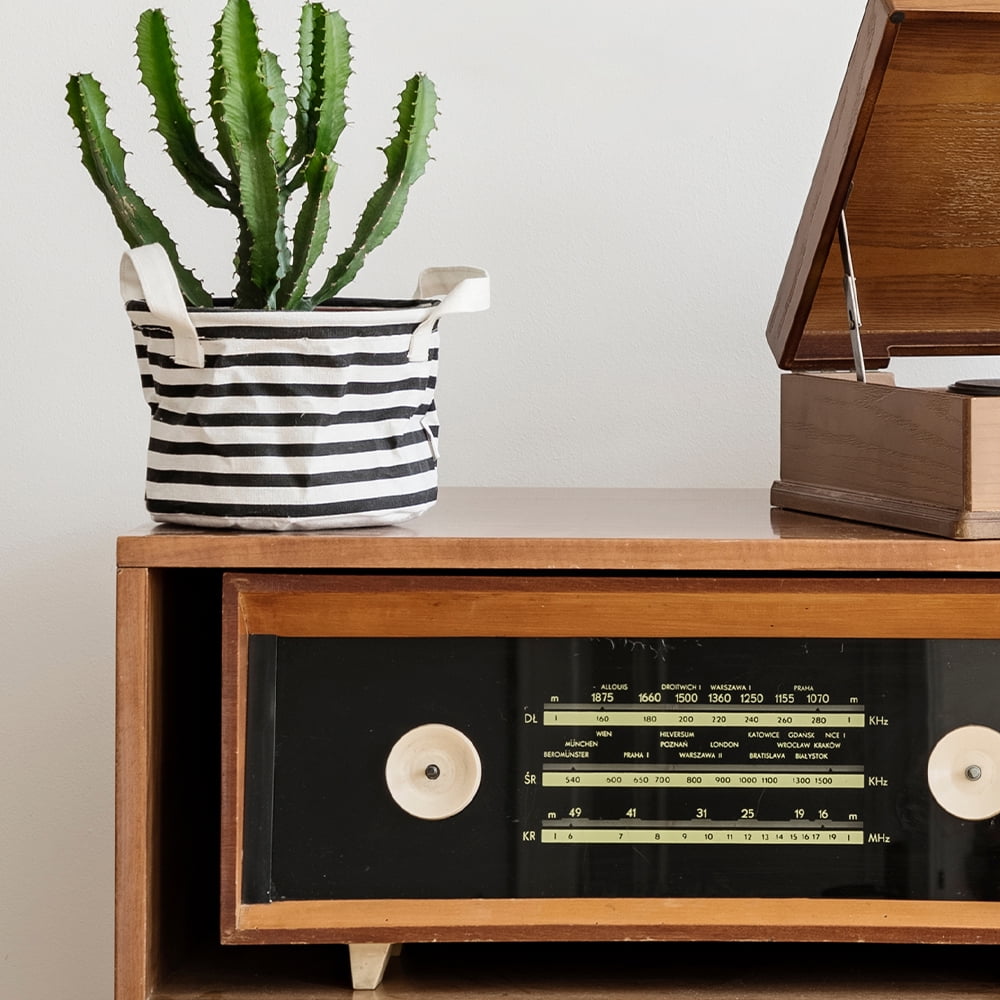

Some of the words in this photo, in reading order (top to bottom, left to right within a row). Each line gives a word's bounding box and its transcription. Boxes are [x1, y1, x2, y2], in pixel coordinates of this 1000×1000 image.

[600, 683, 629, 691] ALLOUIS
[660, 683, 697, 691] DROITWICH
[793, 684, 814, 692] PRAHA
[550, 695, 560, 703] m
[590, 692, 615, 703] 1875
[638, 692, 662, 703] 1660
[675, 692, 699, 704] 1500
[707, 692, 732, 704] 1360
[740, 692, 764, 704] 1250
[774, 693, 795, 704] 1155
[806, 693, 830, 704] 1070
[849, 696, 859, 704] m
[643, 715, 658, 723] 180
[678, 715, 694, 723] 200
[711, 715, 727, 724] 220
[744, 716, 759, 724] 240
[777, 716, 793, 724] 260
[811, 716, 827, 725] 280
[868, 715, 889, 726] KHz
[595, 730, 613, 738] WIEN
[659, 730, 695, 738] HILVERSUM
[747, 731, 780, 739] KATOWICE
[824, 731, 840, 739] NICE
[709, 740, 740, 749] LONDON
[623, 751, 644, 759] PRAHA
[678, 751, 716, 759] WARSZAWA
[749, 752, 786, 760] BRATISLAVA
[524, 771, 537, 785] ŚR
[565, 776, 581, 784] 540
[606, 776, 623, 784] 600
[633, 776, 649, 784] 650
[655, 776, 671, 784] 700
[686, 776, 703, 784] 800
[714, 776, 731, 784] 900
[738, 776, 758, 784] 1000
[761, 776, 778, 784] 1100
[814, 776, 833, 785] 1500
[868, 776, 889, 787] KHz
[547, 811, 557, 819] m
[568, 807, 582, 818] 49
[625, 807, 637, 818] 41
[695, 807, 707, 819] 31
[740, 808, 755, 819] 25
[794, 808, 805, 819] 19
[818, 809, 829, 819] 16
[848, 813, 858, 821] m
[522, 830, 536, 842] KR
[704, 832, 714, 841] 10
[761, 833, 770, 841] 13
[801, 833, 810, 841] 16
[812, 833, 821, 841] 17
[828, 833, 837, 841] 19
[867, 833, 891, 844] MHz
